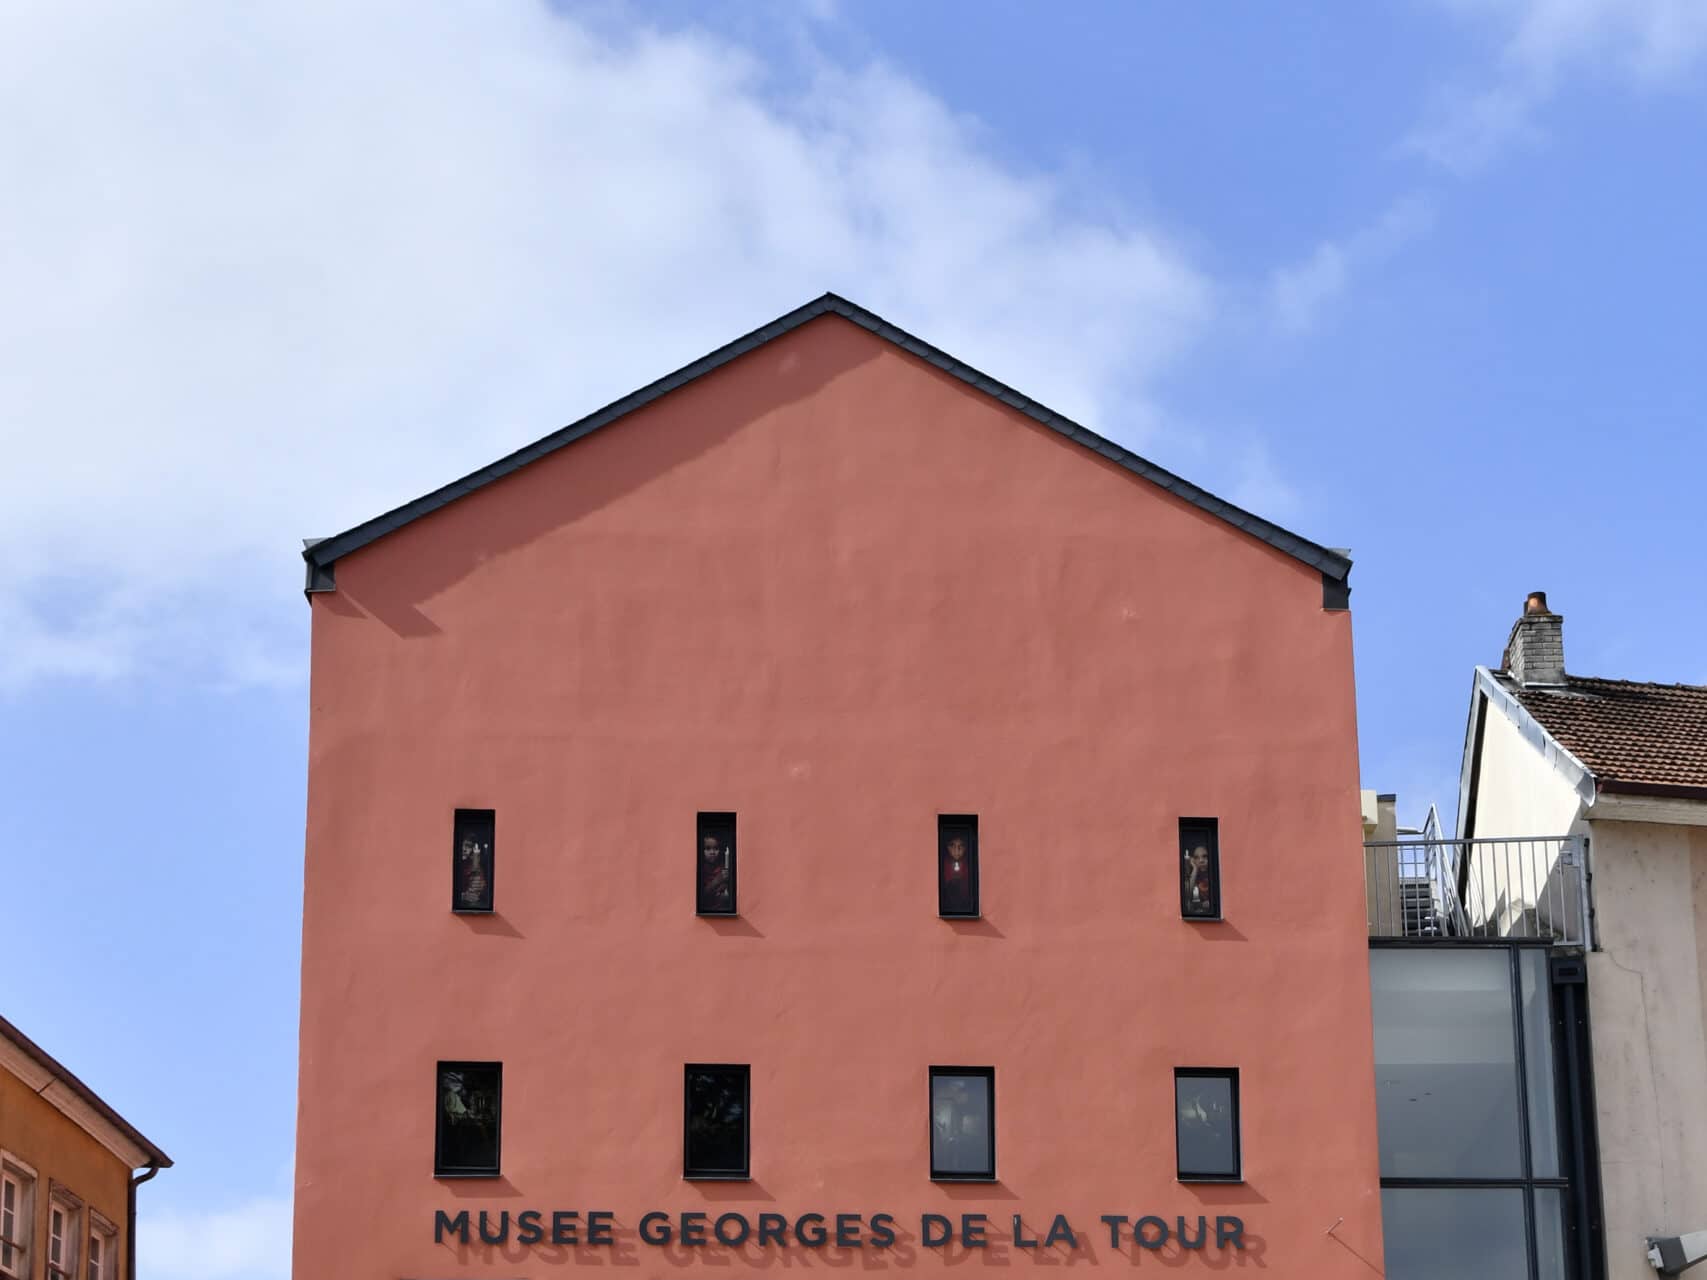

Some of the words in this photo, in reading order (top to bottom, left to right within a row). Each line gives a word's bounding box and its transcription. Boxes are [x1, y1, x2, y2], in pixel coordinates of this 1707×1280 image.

[434, 1210, 614, 1245] MUSEE
[639, 1211, 895, 1248] GEORGES
[922, 1213, 987, 1248] DE
[1013, 1214, 1077, 1248] LA
[1100, 1215, 1244, 1249] TOUR
